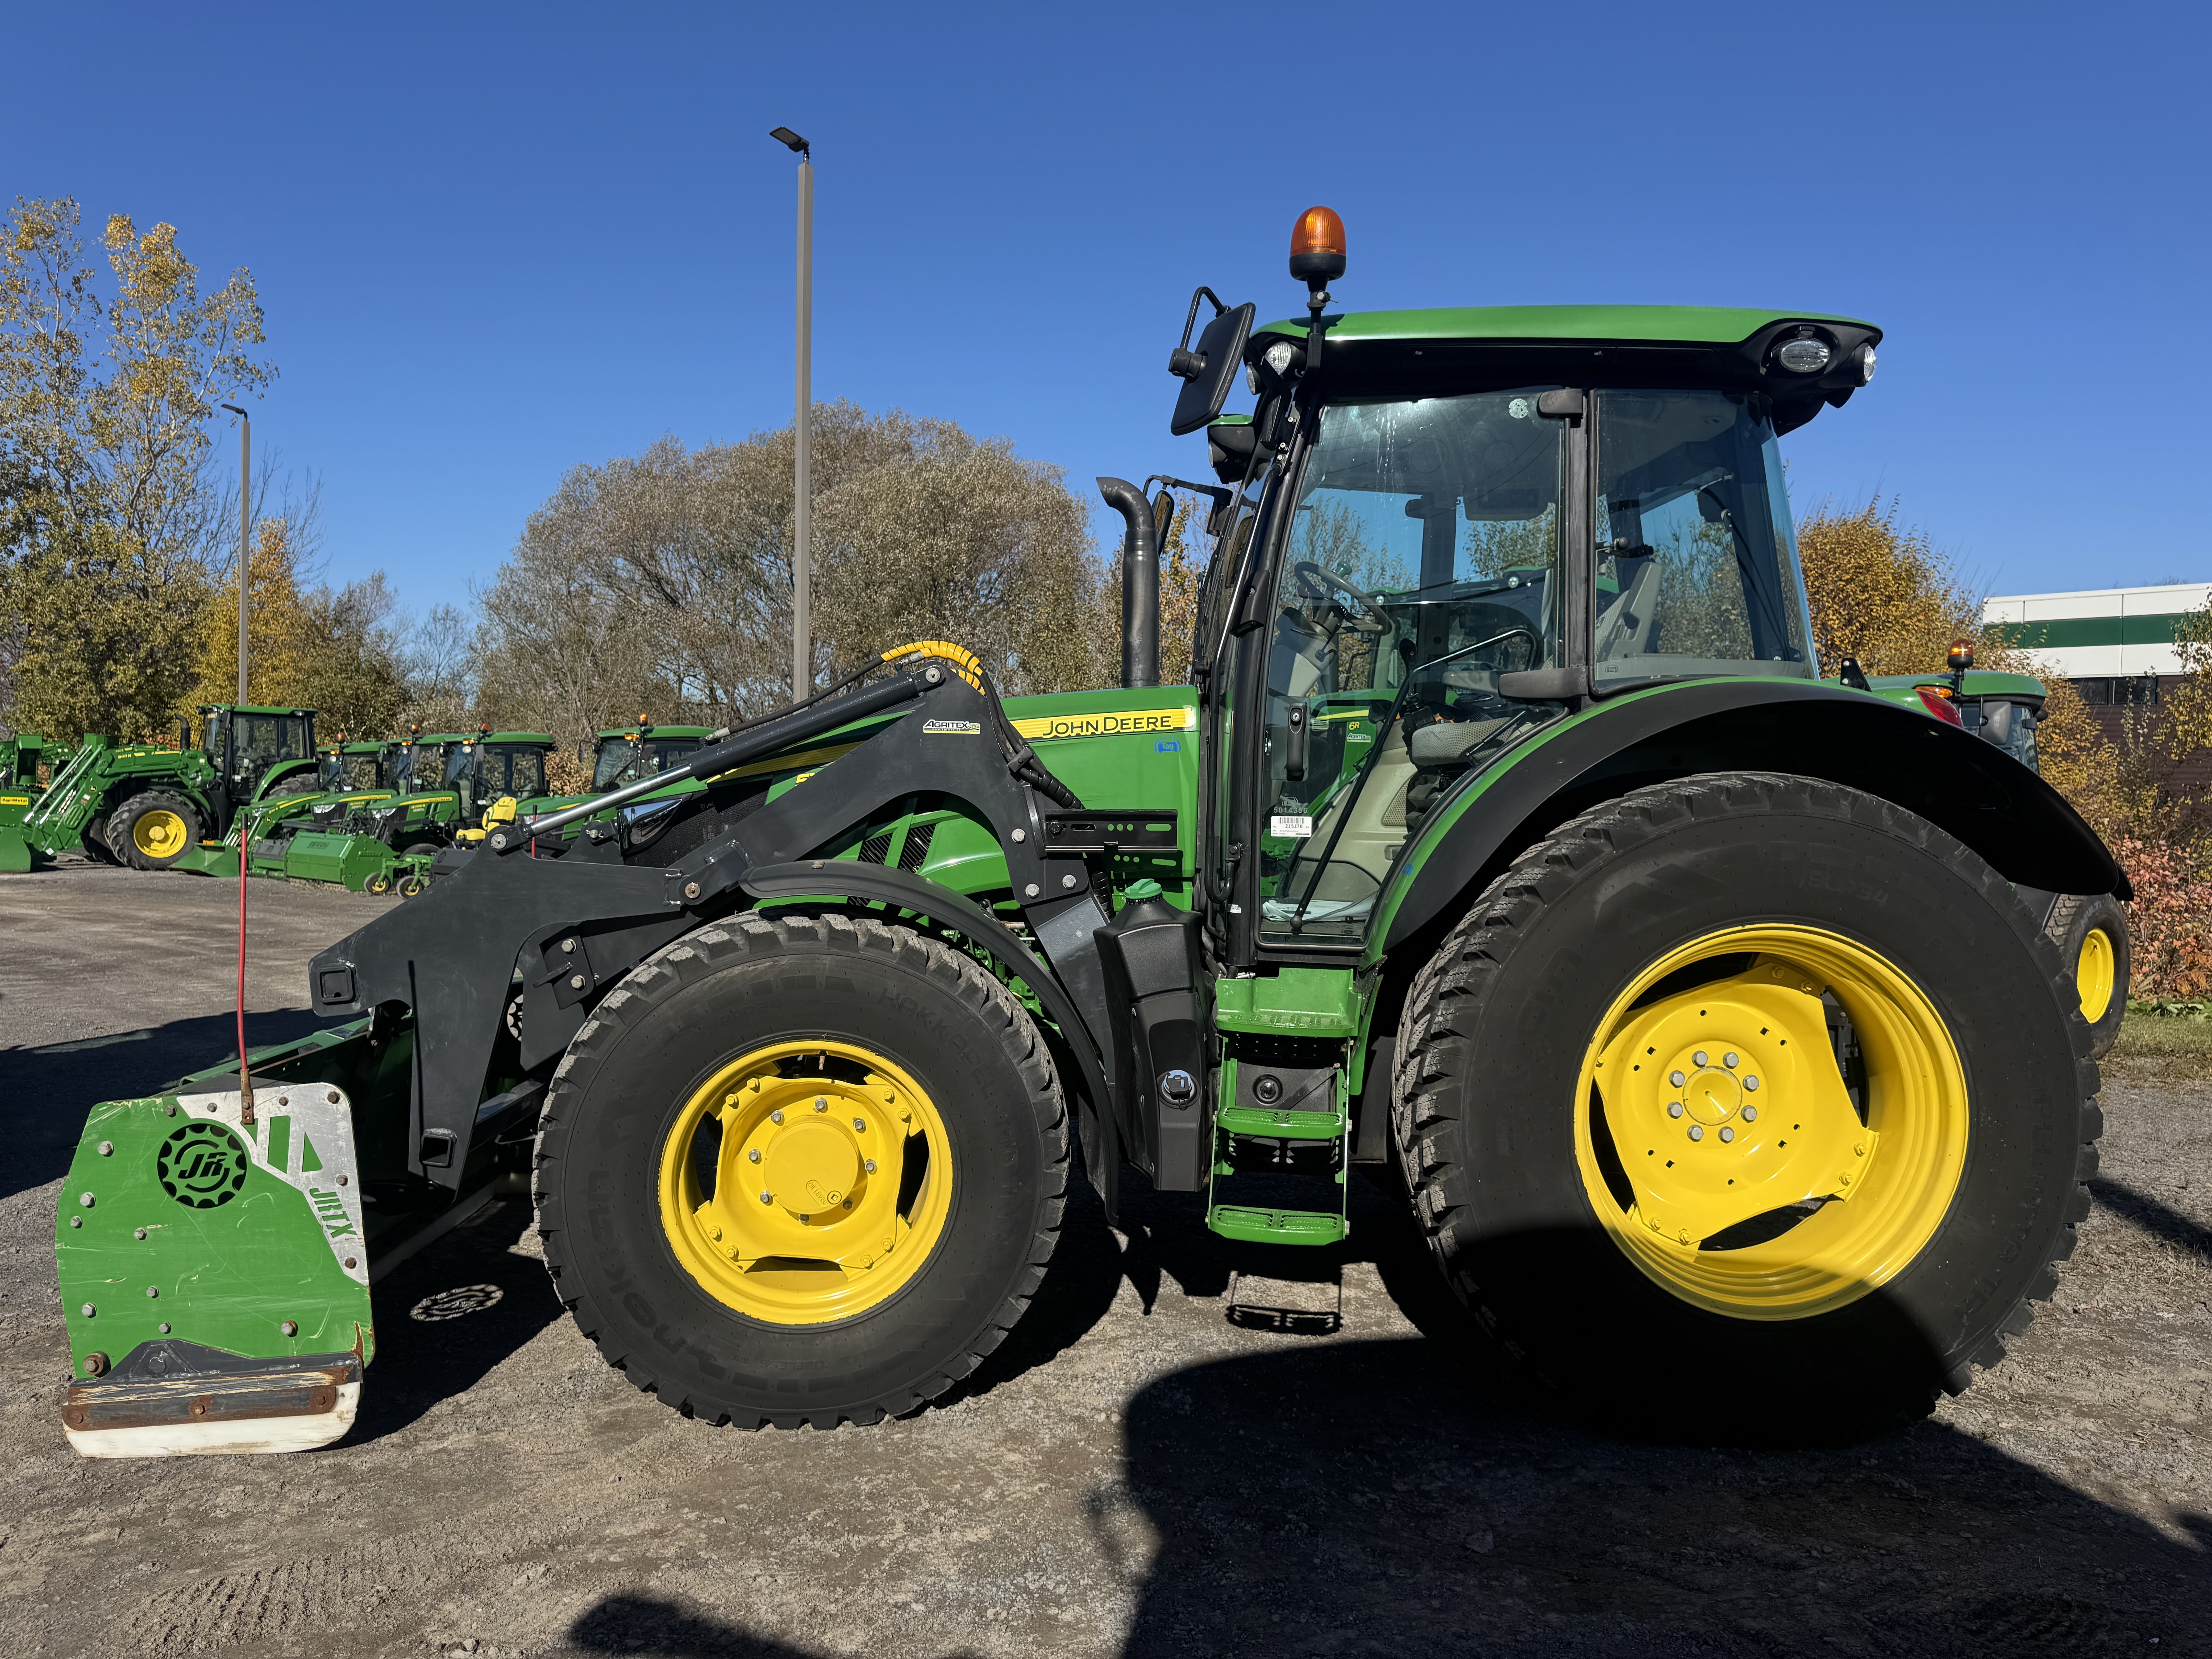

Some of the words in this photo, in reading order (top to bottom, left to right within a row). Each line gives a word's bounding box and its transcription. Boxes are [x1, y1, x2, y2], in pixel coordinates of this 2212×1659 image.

[1042, 720, 1099, 736] JOHN
[1104, 716, 1171, 732] DEERE
[1349, 722, 1360, 730] 6R
[177, 1152, 228, 1179] JR
[813, 1188, 826, 1205] LEVEL
[309, 1187, 358, 1238] JRTX
